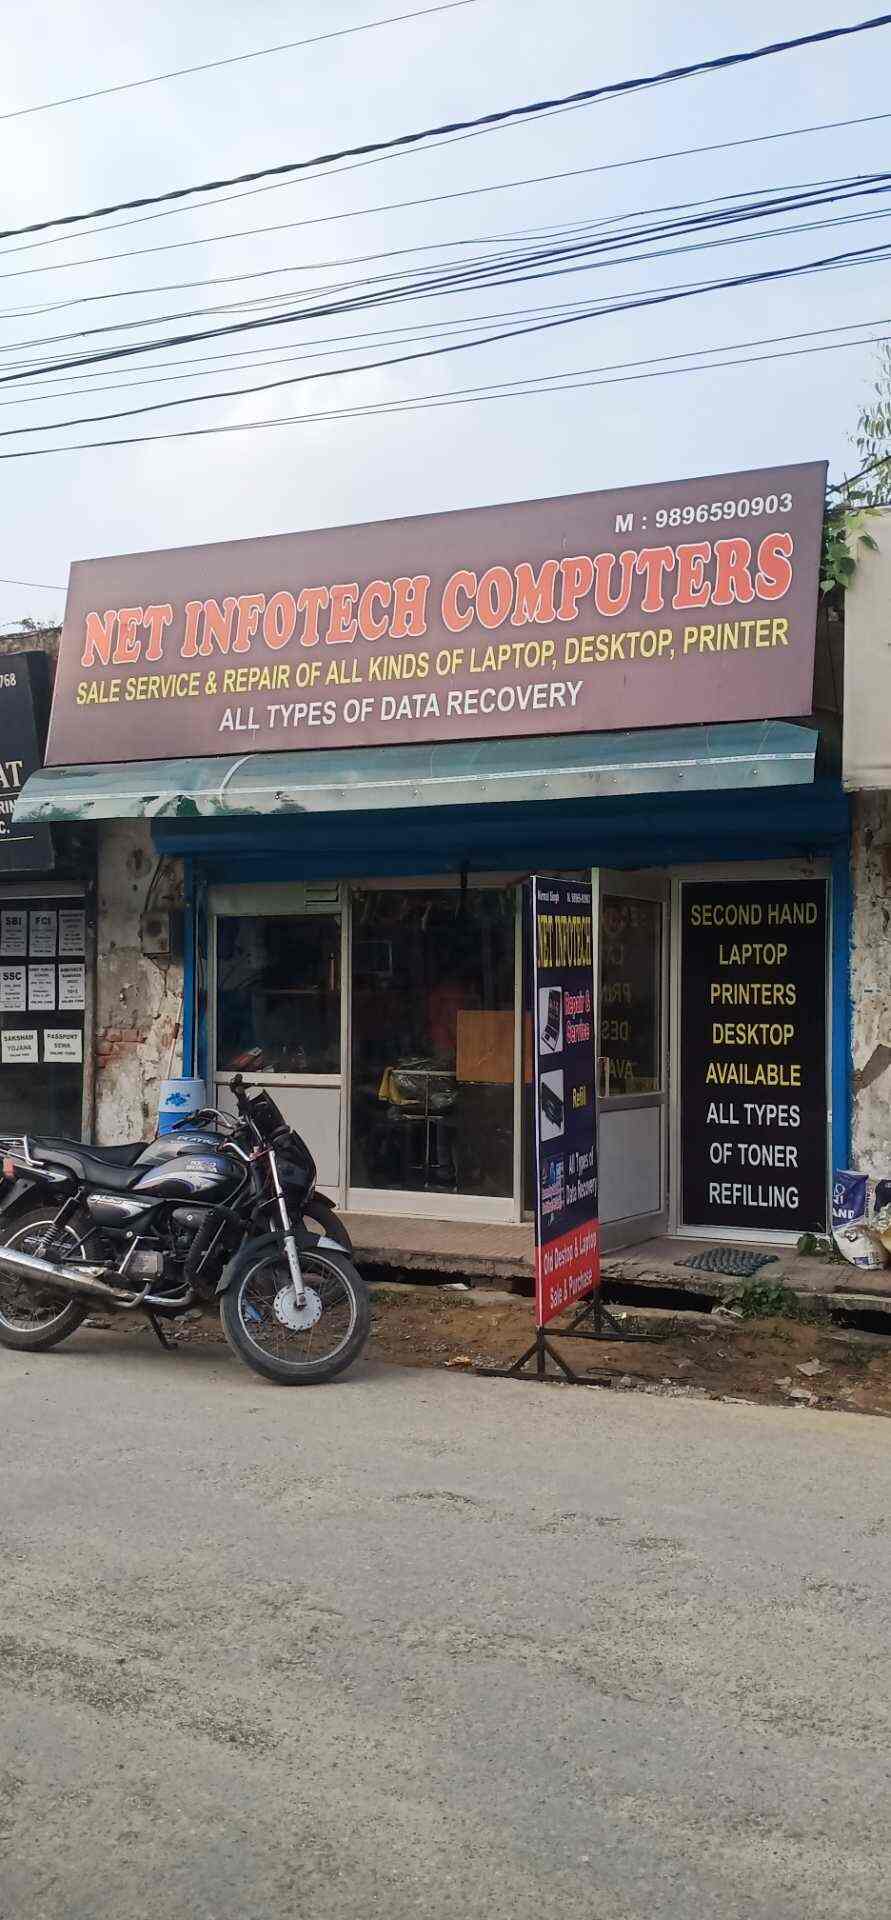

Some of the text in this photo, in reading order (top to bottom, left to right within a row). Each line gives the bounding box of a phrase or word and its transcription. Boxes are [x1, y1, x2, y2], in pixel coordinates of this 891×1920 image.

[615, 513, 633, 533] M
[655, 493, 793, 529] 9896590903
[81, 533, 793, 667] NET INFOTECH COMPUTERS
[77, 617, 789, 704] SALE SERVICE & REPAIR OF ALL KINDS OF LAPTOP, DESKTOP, PRINTER
[218, 680, 584, 731] ALL TYPES OF DATA RECOVERY
[691, 902, 818, 926] SECOND HAND
[537, 915, 553, 967] NET
[555, 915, 591, 967] INFOTECH
[719, 944, 788, 966] LAPTOP
[3, 971, 22, 981] SSC
[564, 991, 584, 1019] Repair
[710, 983, 797, 1005] PRINTERS
[47, 1033, 78, 1041] PASSPORT
[566, 1020, 590, 1043] Service
[712, 1023, 794, 1045] DESKTOP
[705, 1062, 801, 1087] AVAILABLE
[572, 1085, 587, 1109] Refill
[706, 1103, 801, 1127] ALL TYPES
[576, 1151, 589, 1176] Types
[709, 1142, 799, 1169] OF TONER
[566, 1178, 597, 1205] Data Recovery
[709, 1182, 800, 1209] REFILLING
[544, 1249, 554, 1275] Old
[579, 1231, 597, 1257] Laptop
[550, 1283, 563, 1309] Sale
[569, 1267, 592, 1297] Purchase
